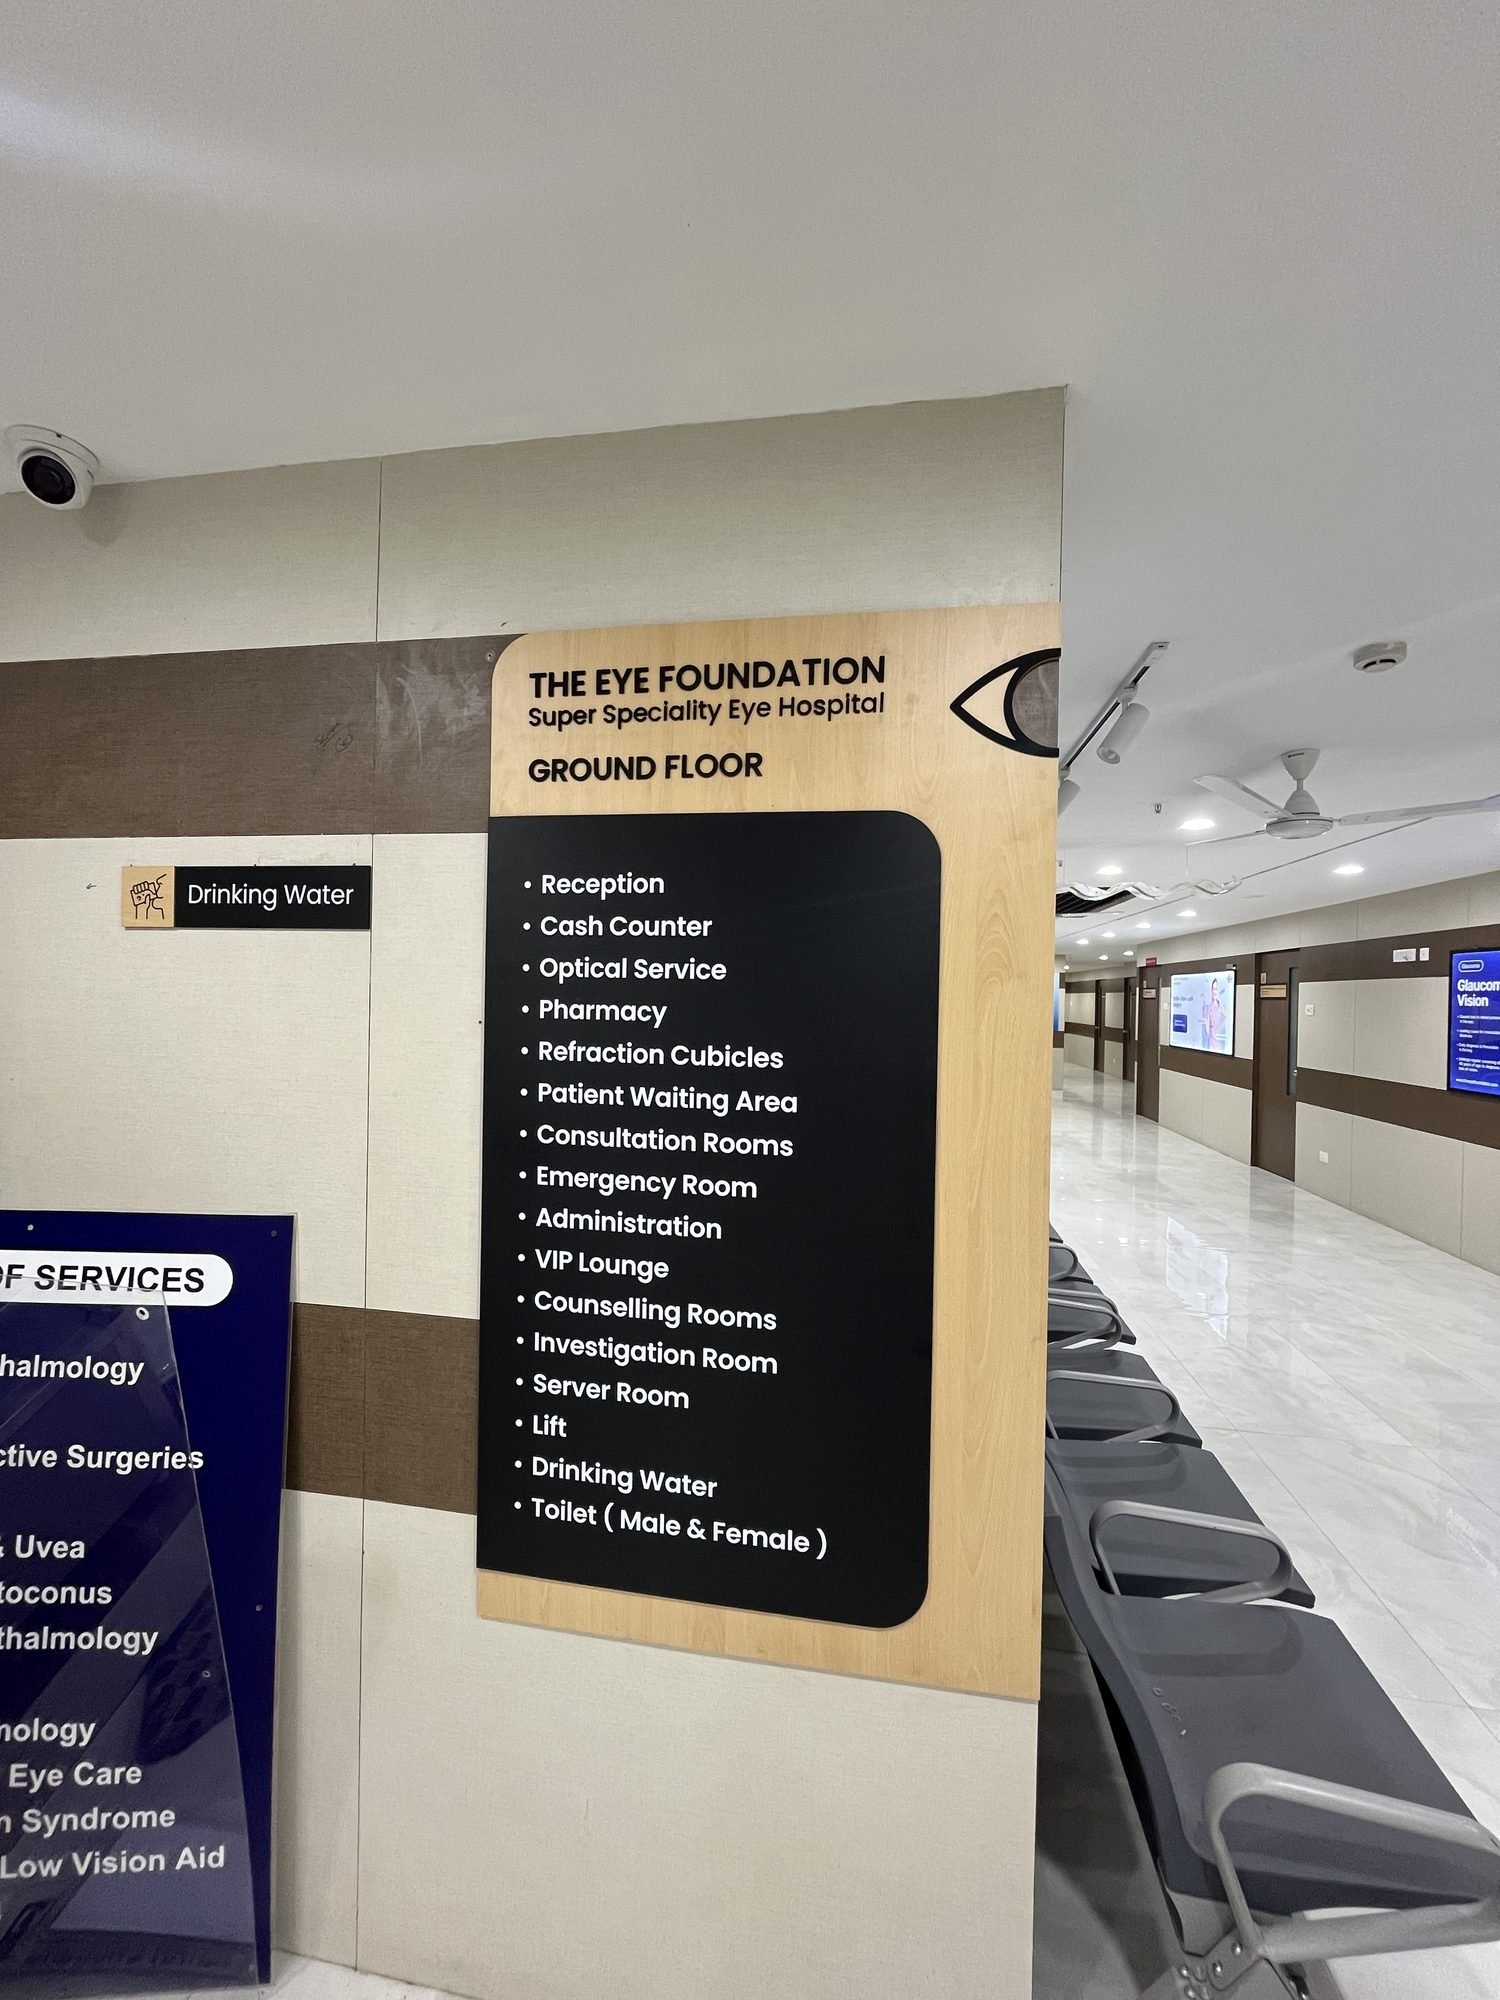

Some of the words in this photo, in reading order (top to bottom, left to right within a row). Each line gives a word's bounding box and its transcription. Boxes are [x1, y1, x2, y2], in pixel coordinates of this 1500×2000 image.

[529, 670, 586, 699] THE
[596, 666, 649, 696] EYE
[659, 655, 886, 692] FOUNDATION
[529, 708, 597, 732] Super
[603, 699, 722, 730] Speciality
[729, 699, 771, 726] Eye
[779, 692, 885, 722] Hospital
[529, 756, 657, 783] GROUND
[665, 752, 763, 780] FLOOR
[188, 883, 277, 911] Drinking
[284, 885, 355, 905] Water
[541, 872, 665, 900] Reception
[541, 915, 604, 936] Cash
[609, 916, 713, 937] Counter
[540, 956, 627, 984] Optical
[633, 957, 727, 981] Service
[539, 999, 668, 1029] Pharmacy
[1456, 993, 1489, 1007] Vision
[538, 1040, 665, 1065] Refraction
[671, 1044, 784, 1069] Cubicles
[538, 1082, 625, 1106] Patient
[630, 1086, 729, 1118] Waiting
[735, 1090, 798, 1113] Area
[537, 1124, 697, 1152] Consultation
[703, 1132, 794, 1157] Rooms
[537, 1166, 676, 1200] Emergency
[683, 1174, 758, 1198] Room
[535, 1208, 722, 1240] Administration
[0, 1264, 25, 1288] F
[34, 1264, 205, 1293] SERVICES
[535, 1249, 573, 1271] VIP
[579, 1252, 669, 1284] Lounge
[534, 1290, 681, 1329] Counselling
[687, 1303, 778, 1331] Rooms
[534, 1331, 696, 1367] Investigation
[702, 1347, 778, 1375] Room
[0, 1353, 145, 1386] halmology
[533, 1373, 611, 1400] Server
[616, 1382, 690, 1409] Room
[533, 1414, 567, 1438] Lift
[67, 1444, 204, 1475] Surgeries
[532, 1456, 634, 1494] Drinking
[640, 1469, 718, 1498] Water
[532, 1497, 597, 1525] Toilet
[604, 1502, 615, 1532] (
[621, 1509, 681, 1537] Male
[687, 1518, 707, 1540] &
[713, 1521, 810, 1553] Female
[817, 1527, 827, 1560] )
[15, 1534, 85, 1559] Uvea
[9, 1763, 63, 1793] Eye
[74, 1762, 142, 1786] Care
[22, 1807, 176, 1838] Syndrome
[0, 1855, 63, 1879] Low
[72, 1850, 165, 1876] Vision
[175, 1845, 225, 1870] Aid
